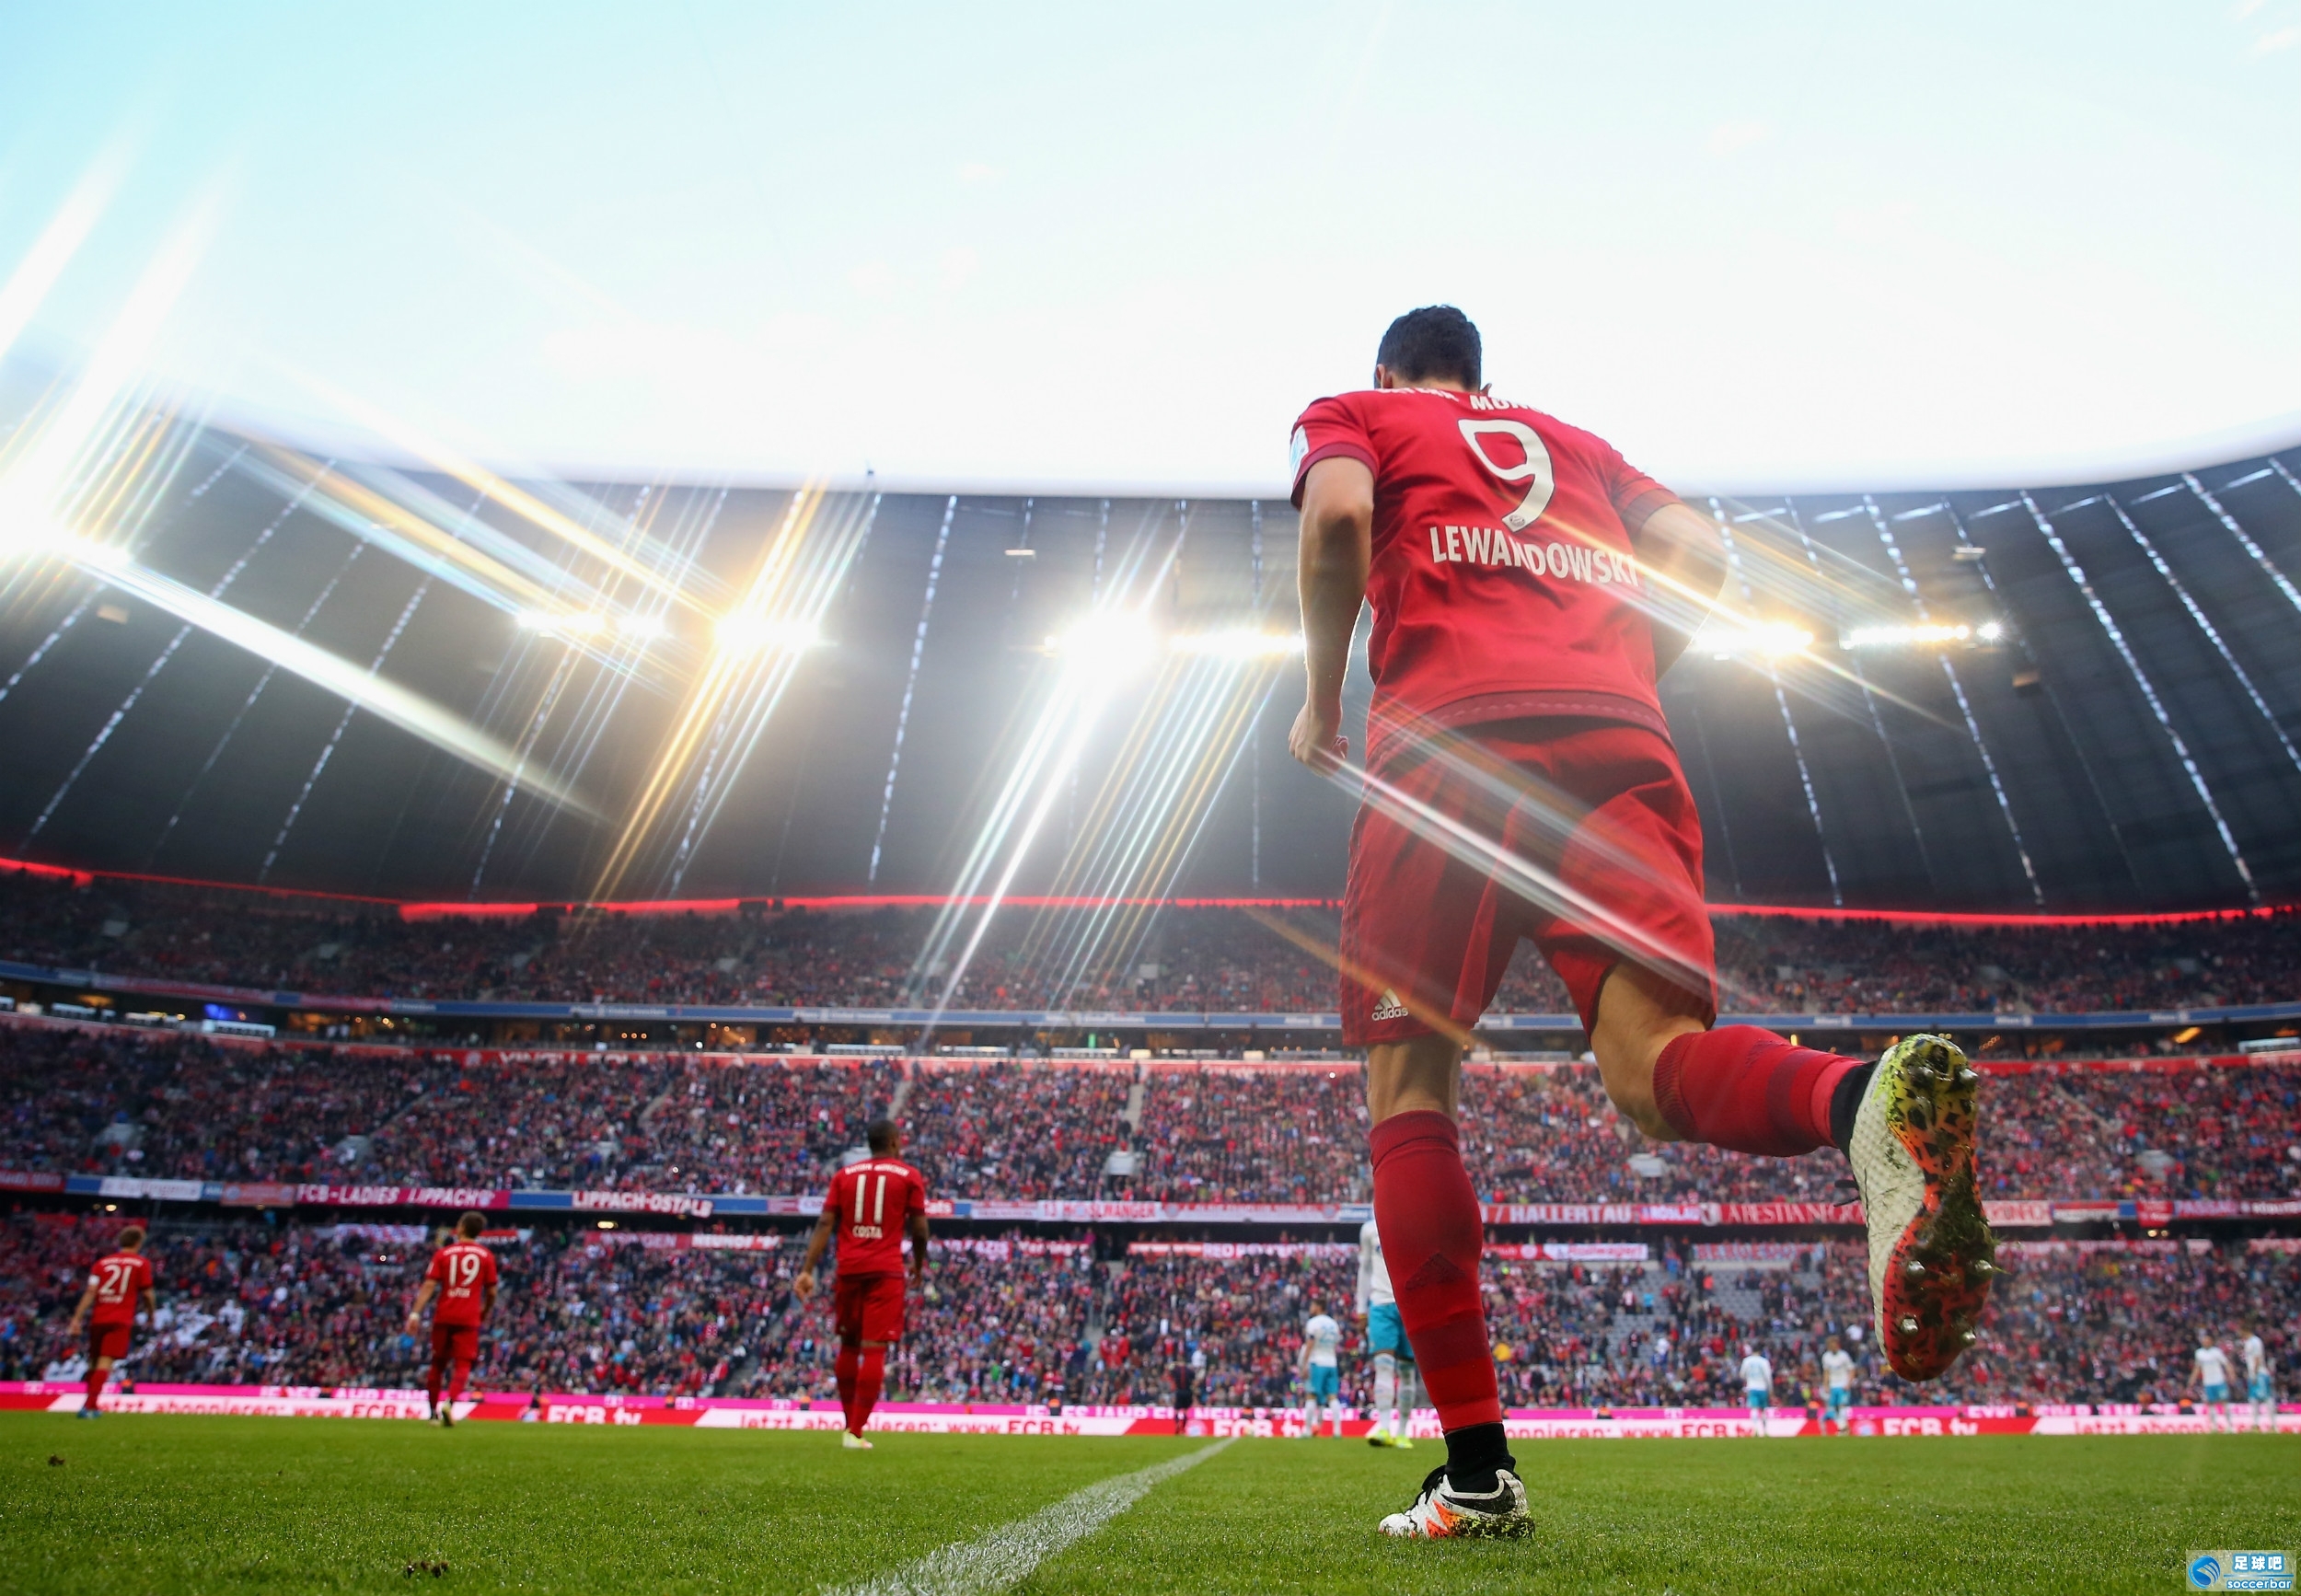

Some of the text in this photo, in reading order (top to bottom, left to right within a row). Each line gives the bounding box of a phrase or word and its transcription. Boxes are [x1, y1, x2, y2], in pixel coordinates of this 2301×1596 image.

[1458, 419, 1555, 532] 9
[1429, 526, 1639, 586] LEWANDOWSKI
[1372, 1007, 1409, 1022] adidas
[297, 1184, 399, 1205] FCB-LADIES
[407, 1187, 480, 1208] LIPPACH
[854, 1174, 886, 1224] 11
[1509, 1204, 1632, 1223] HALLERTAU
[852, 1225, 883, 1239] COSTA
[98, 1264, 133, 1296] 21
[449, 1253, 480, 1288] 19
[99, 1398, 144, 1413] etzt
